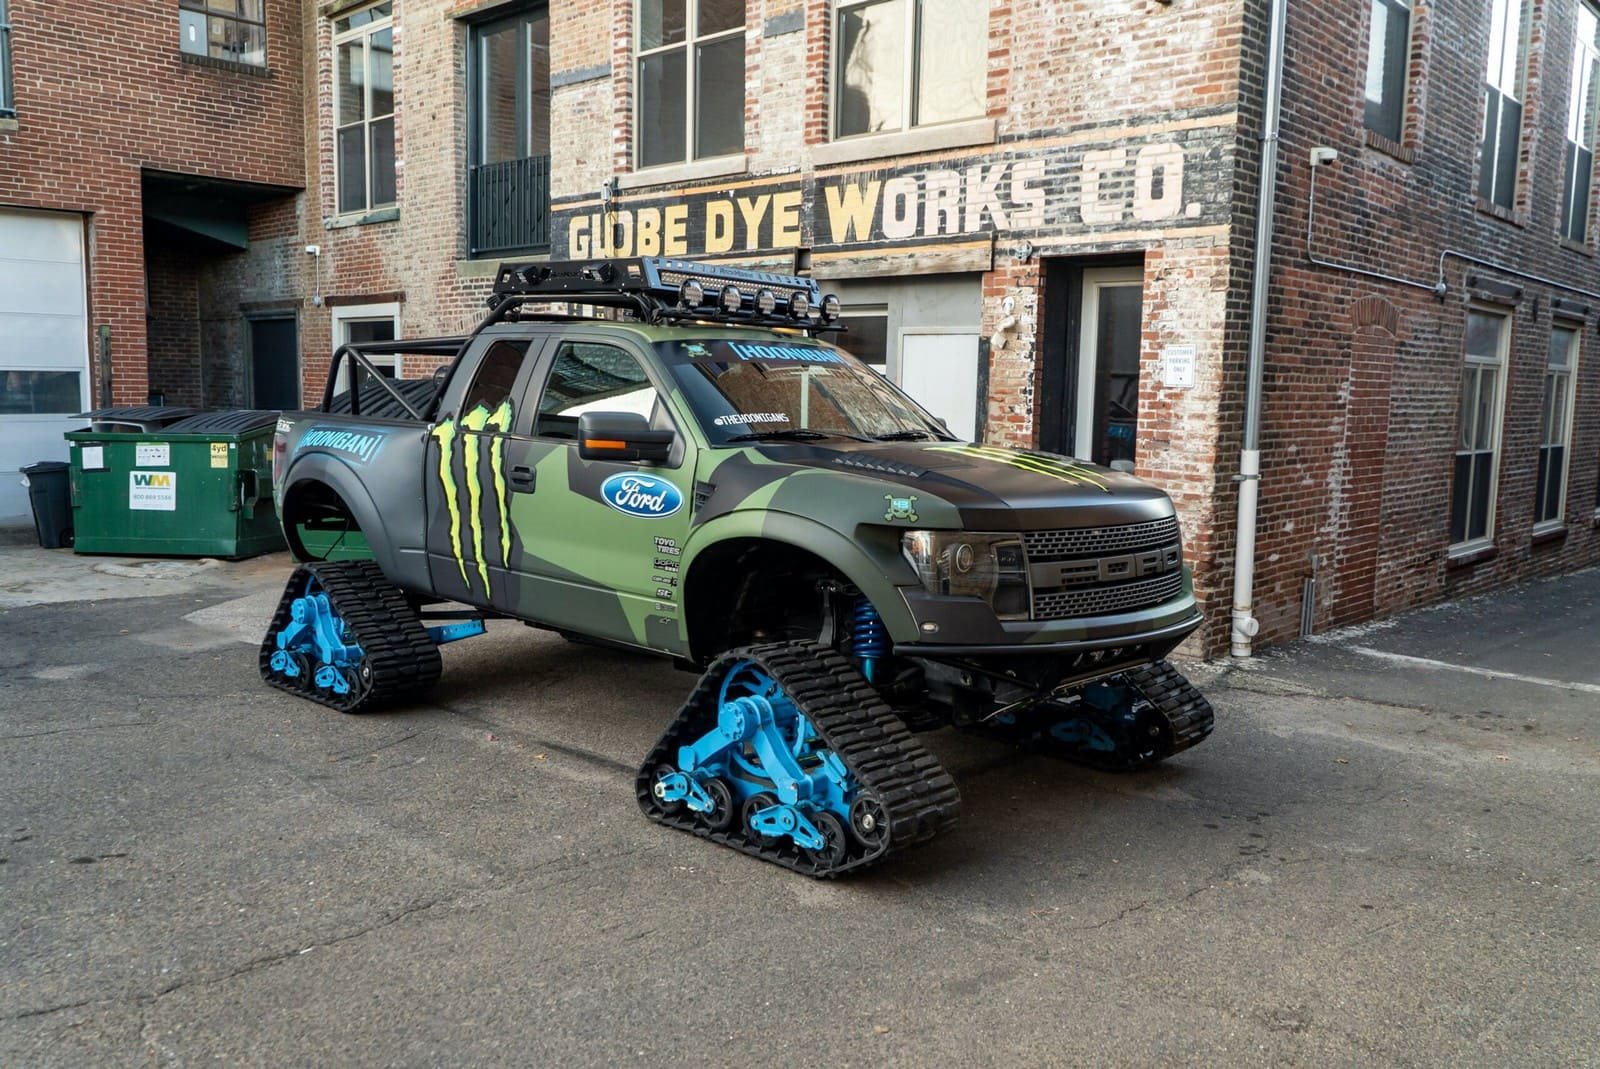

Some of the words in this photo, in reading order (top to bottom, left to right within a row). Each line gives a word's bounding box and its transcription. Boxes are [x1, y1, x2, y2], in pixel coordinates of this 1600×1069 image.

[569, 204, 689, 260] GLOBE
[705, 190, 802, 252] DYE
[824, 159, 1046, 243] WORKS
[1080, 142, 1202, 226] CO.
[133, 474, 171, 487] WM
[616, 477, 667, 511] Ford
[655, 537, 675, 547] TOYO
[658, 545, 680, 555] TIRES
[1030, 544, 1180, 588] FORD
